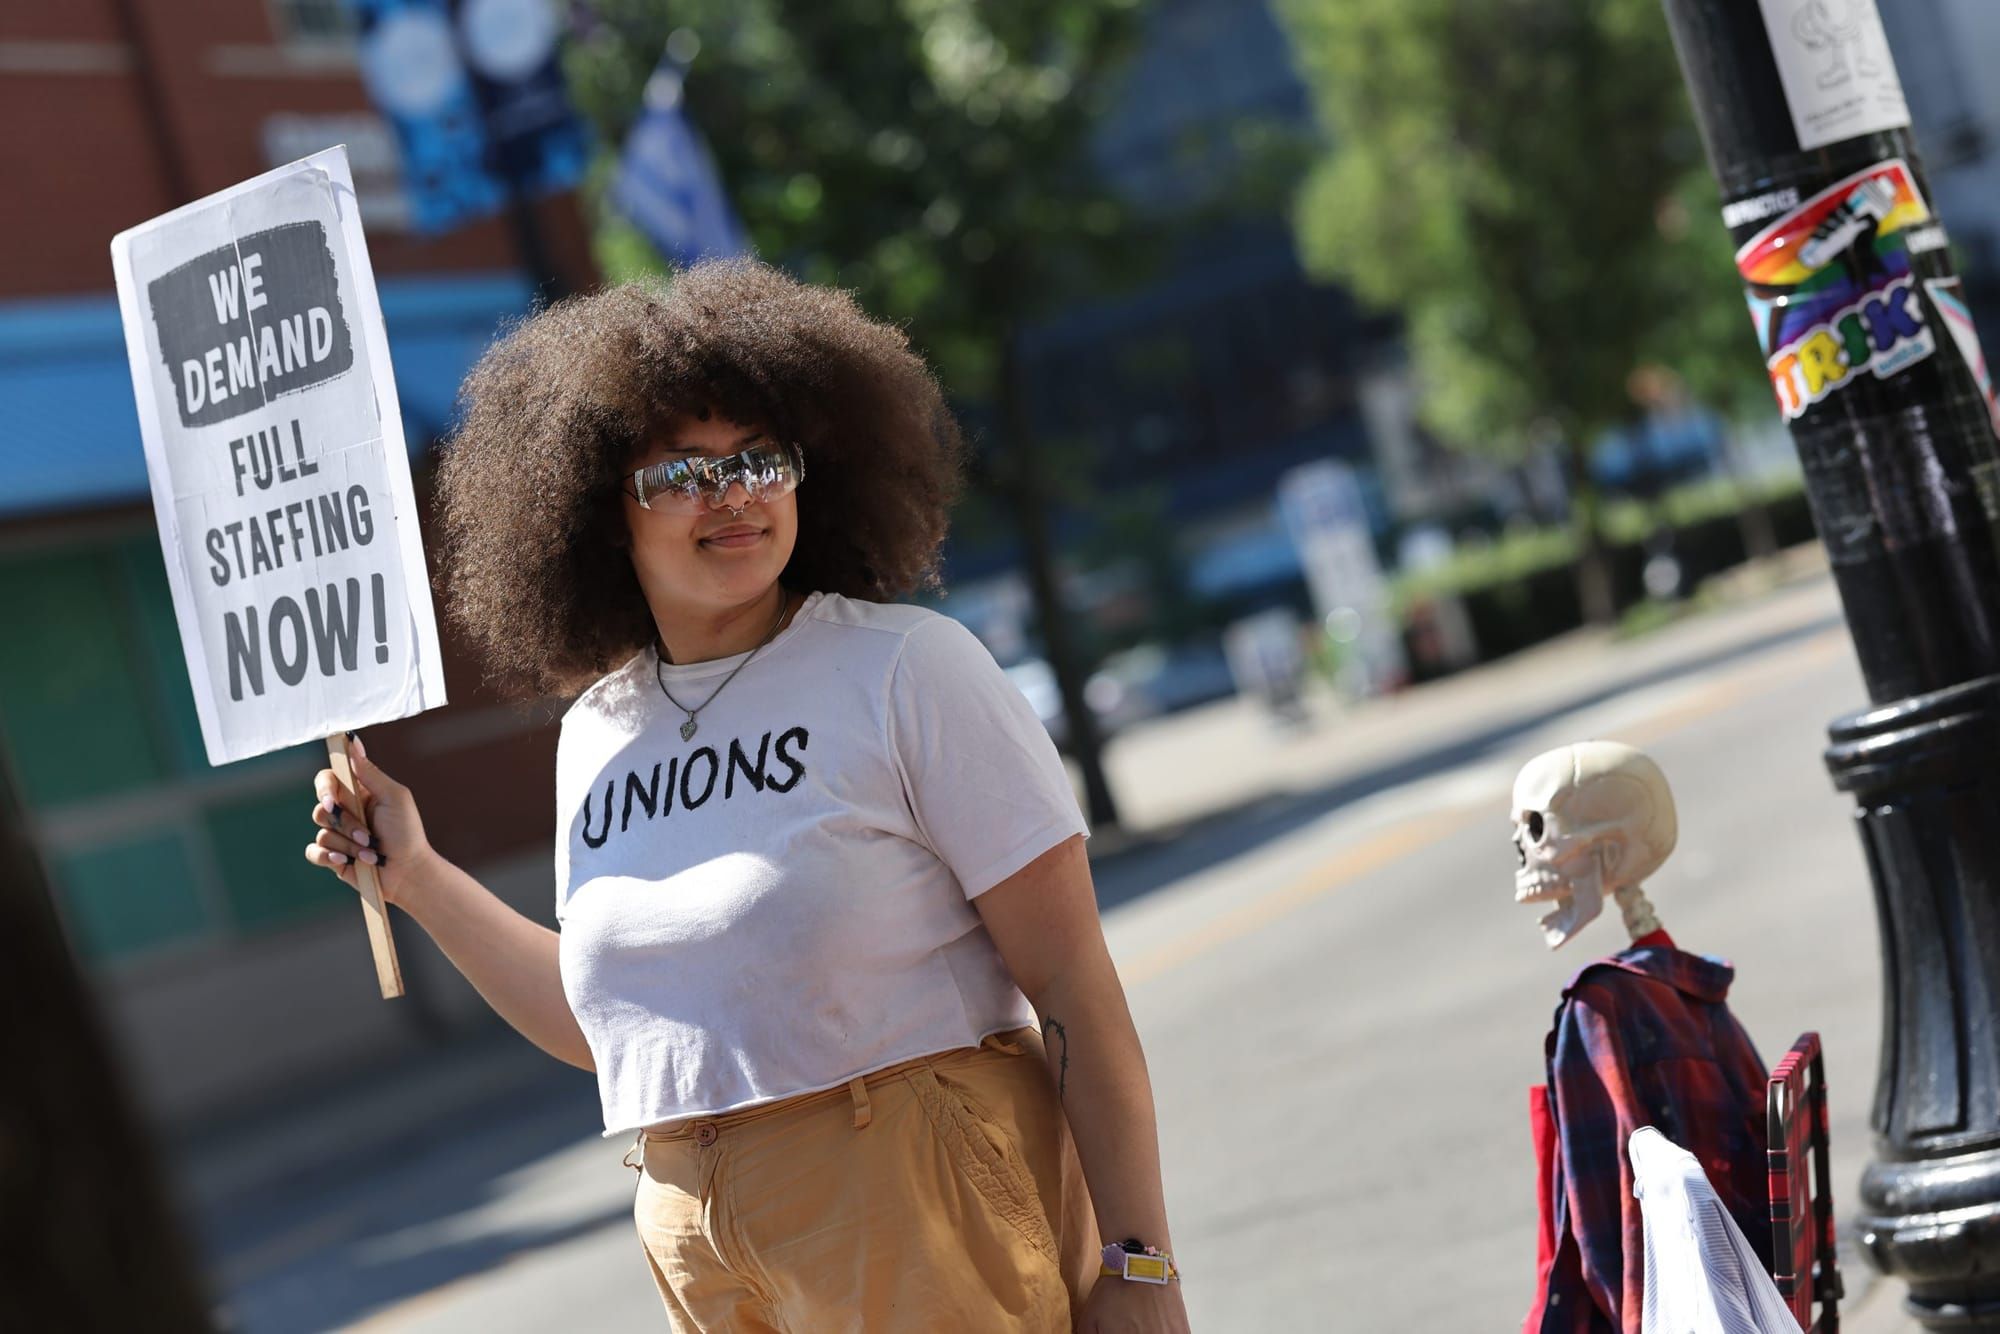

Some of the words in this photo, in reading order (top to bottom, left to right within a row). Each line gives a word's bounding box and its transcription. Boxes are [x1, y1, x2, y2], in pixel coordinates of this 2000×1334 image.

[208, 252, 268, 325] WE
[182, 306, 333, 414] DEMAND
[228, 418, 319, 497] FULL
[205, 484, 375, 587] STAFFING
[223, 572, 390, 702] NOW!
[582, 726, 810, 849] UNIONS
